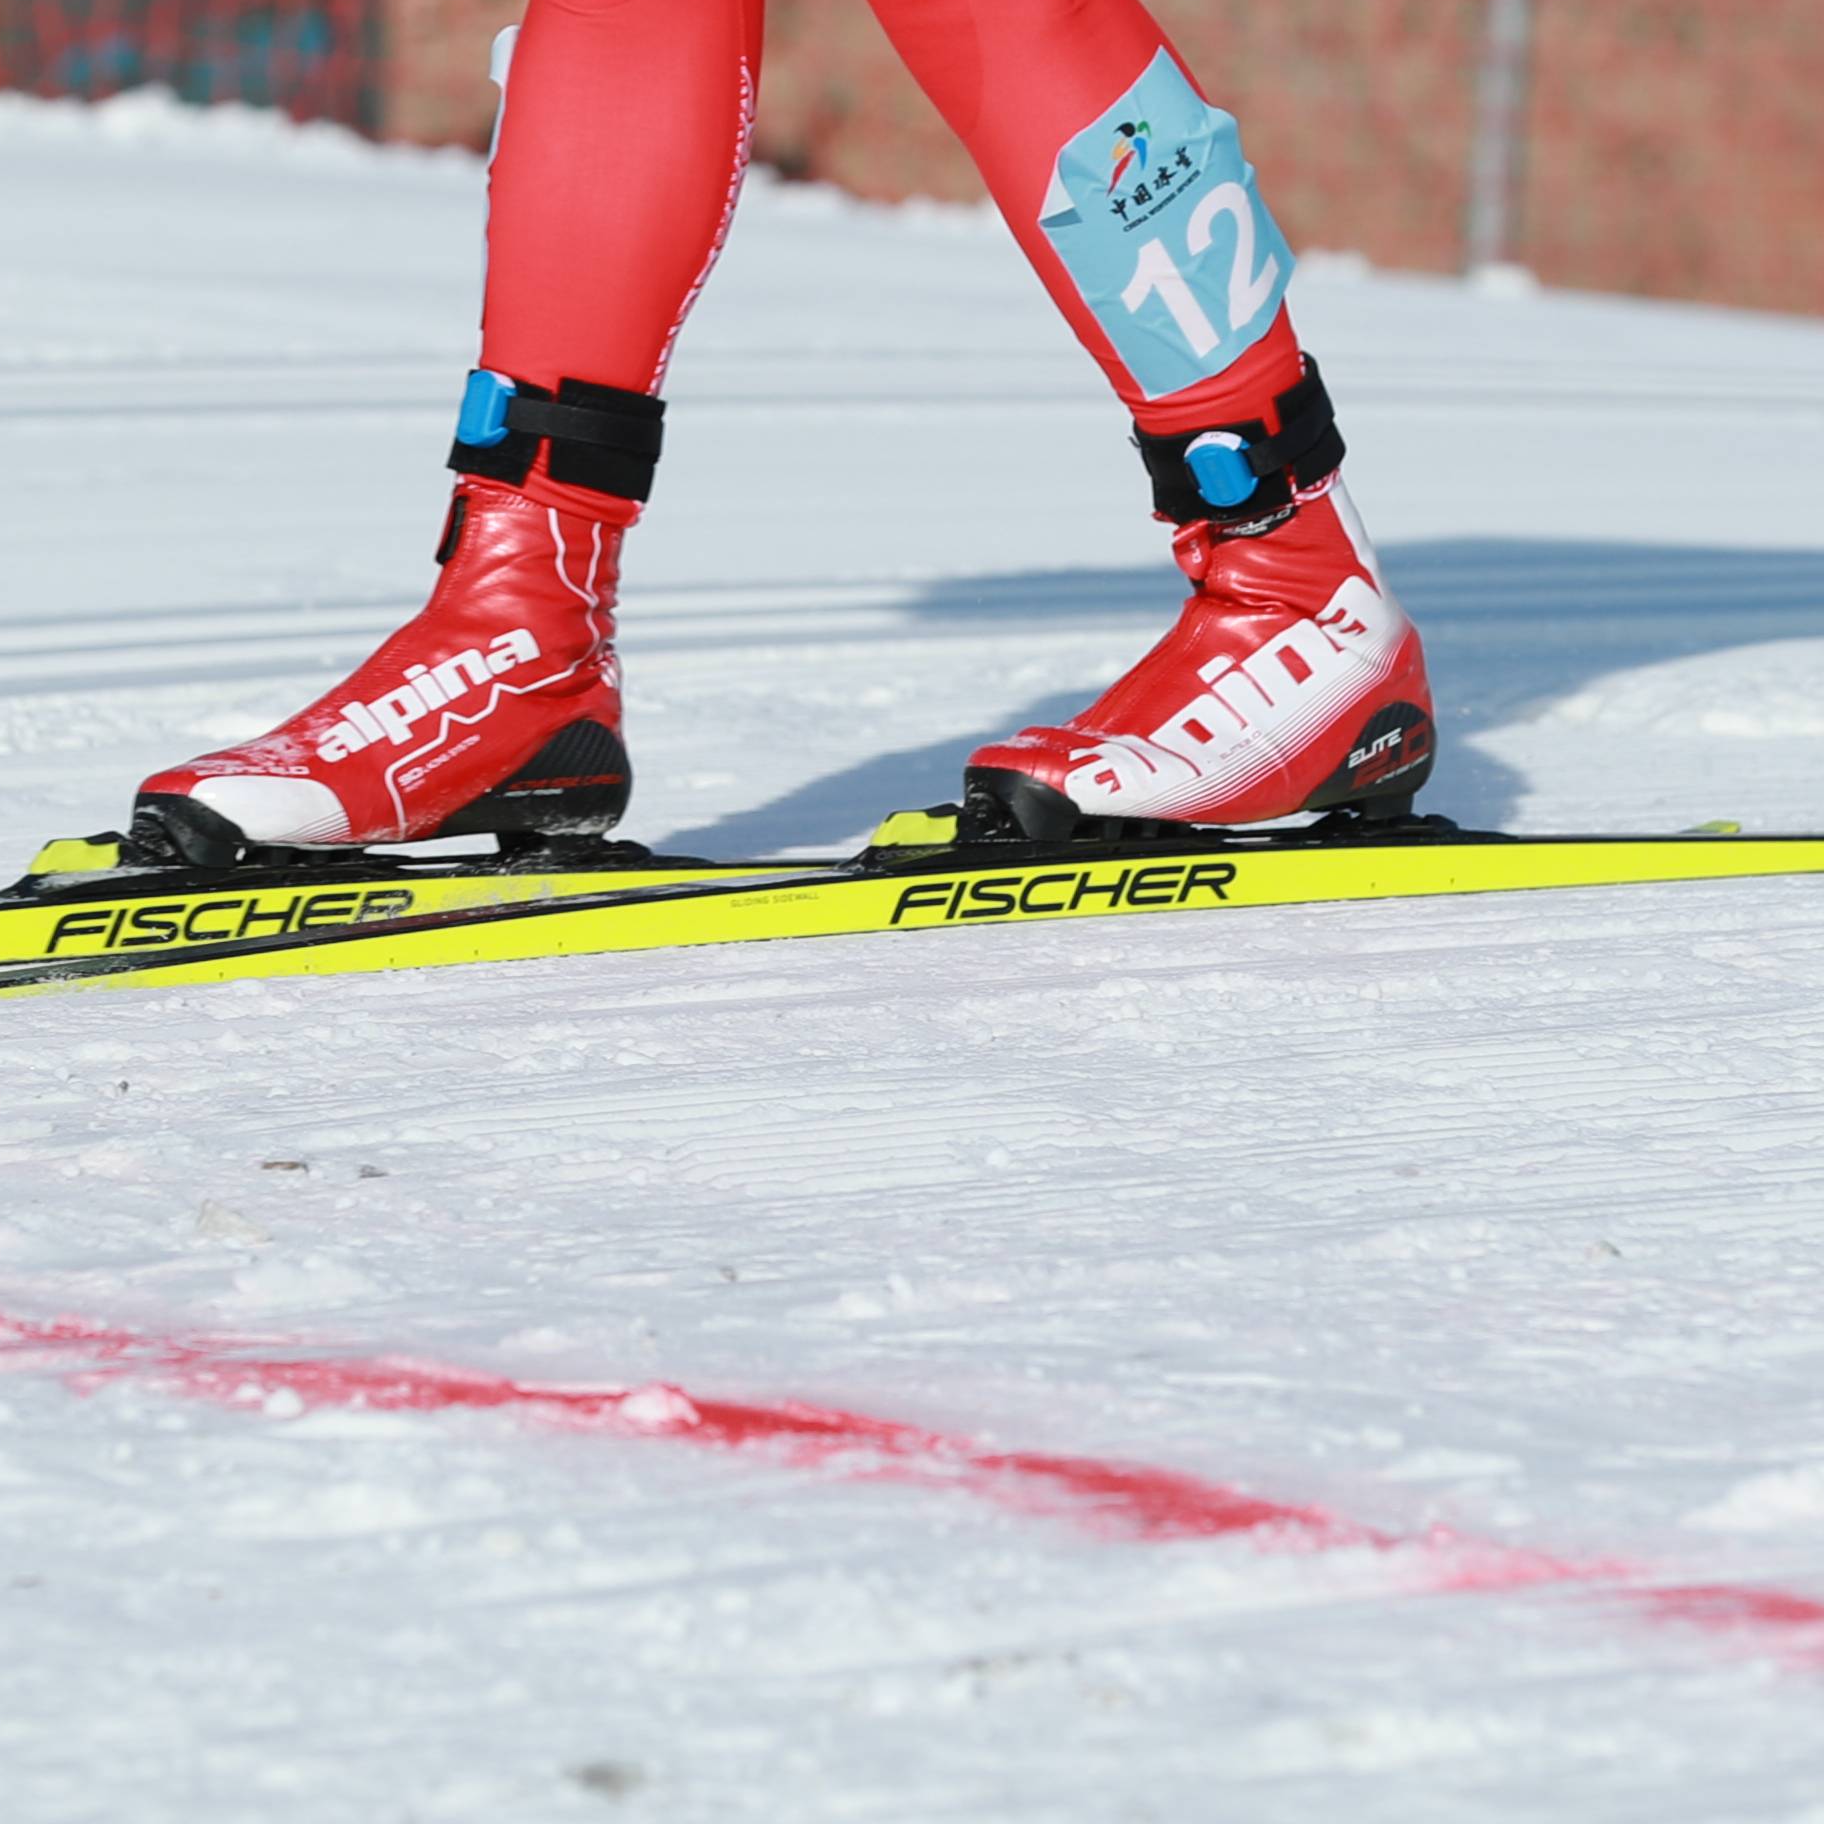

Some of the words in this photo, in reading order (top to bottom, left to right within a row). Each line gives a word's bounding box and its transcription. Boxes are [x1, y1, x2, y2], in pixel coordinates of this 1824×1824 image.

[1120, 181, 1279, 359] 12
[315, 628, 541, 764] alpina
[1063, 575, 1382, 810] alpina
[1348, 727, 1402, 769] ELITE
[46, 889, 414, 953] FISCHER
[889, 863, 1236, 925] FISCHER
